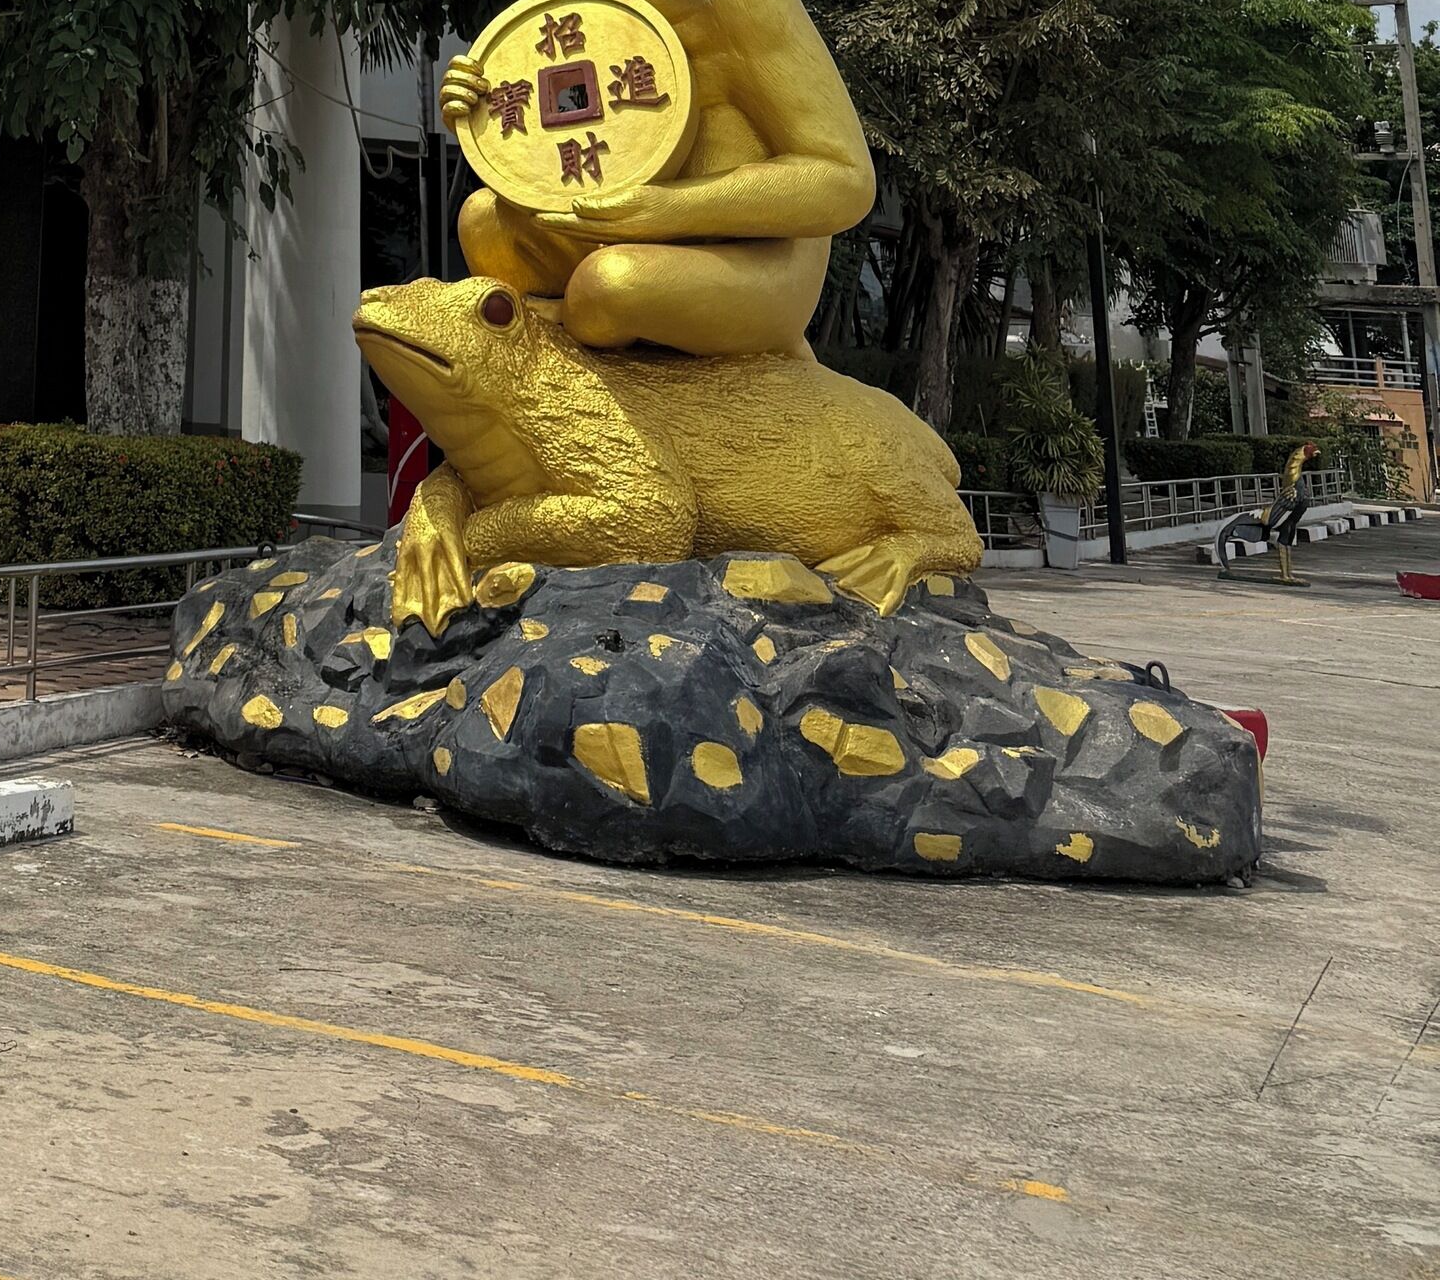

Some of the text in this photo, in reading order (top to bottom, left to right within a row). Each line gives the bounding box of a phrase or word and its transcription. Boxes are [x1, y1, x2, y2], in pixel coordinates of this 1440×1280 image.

[535, 11, 586, 61] 招
[607, 55, 671, 114] 進
[556, 130, 611, 188] 財
